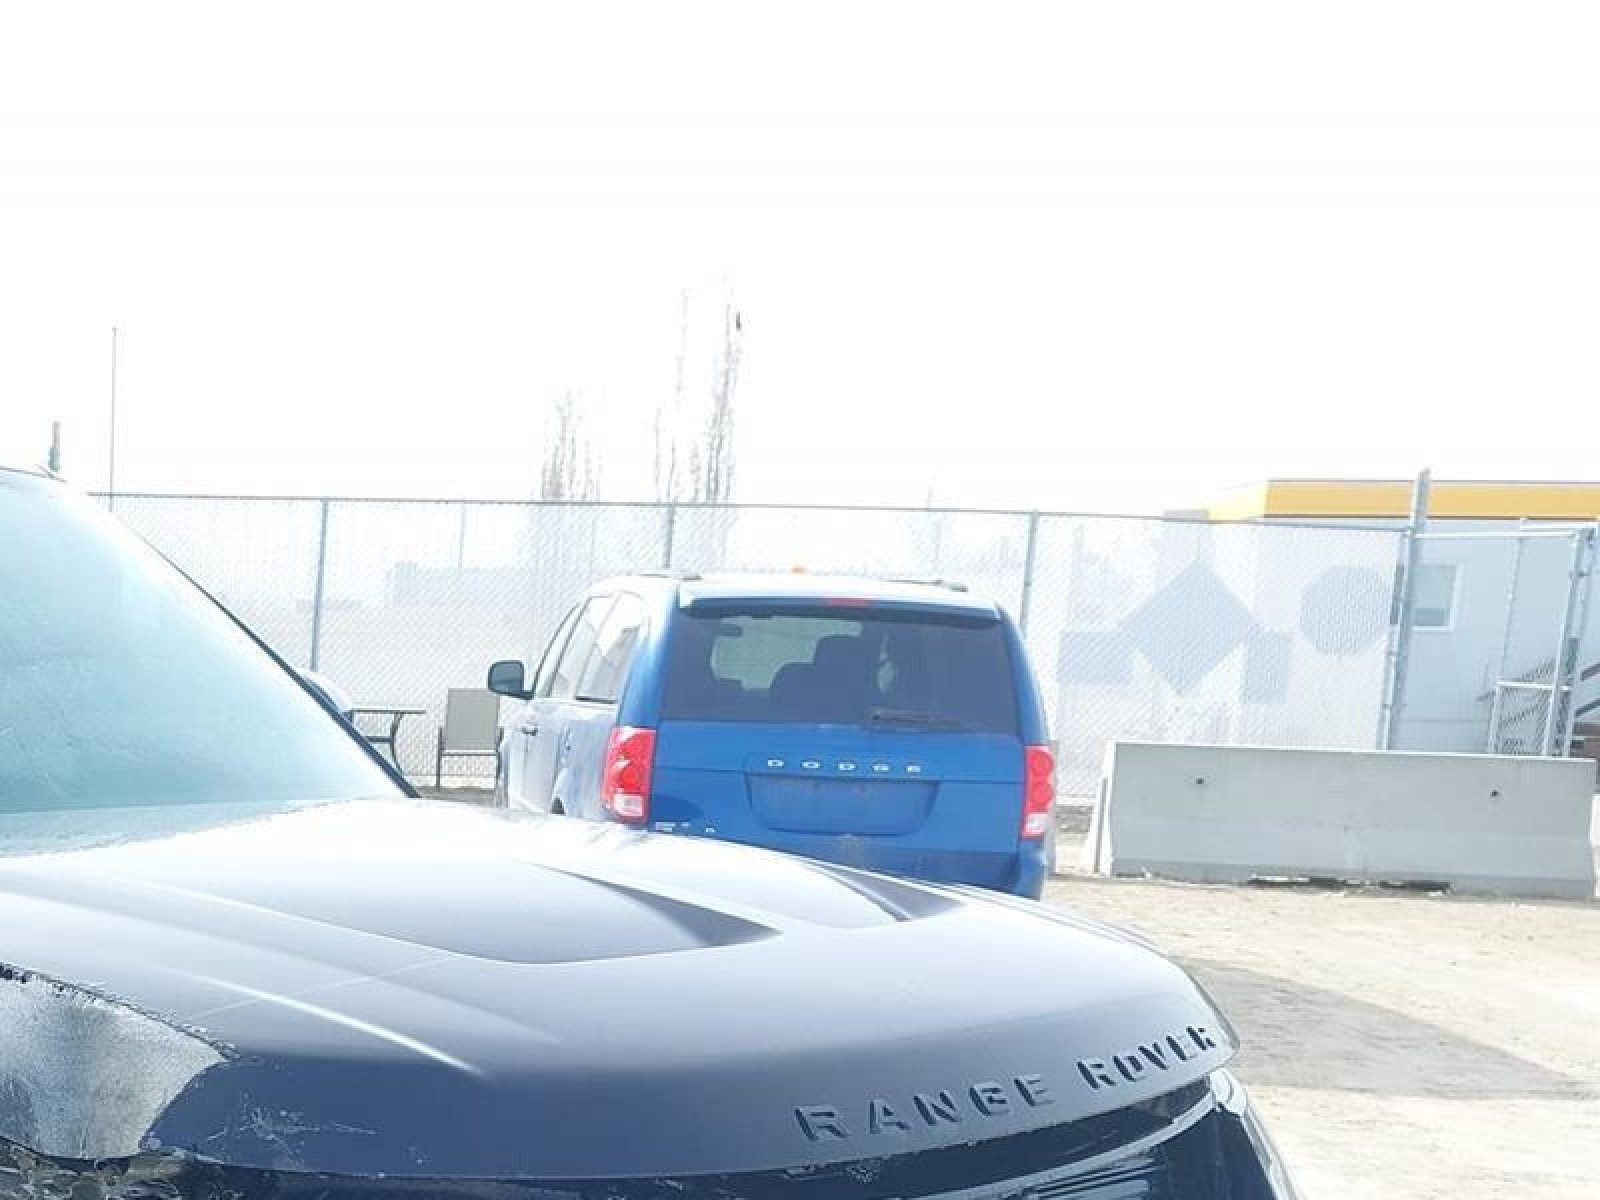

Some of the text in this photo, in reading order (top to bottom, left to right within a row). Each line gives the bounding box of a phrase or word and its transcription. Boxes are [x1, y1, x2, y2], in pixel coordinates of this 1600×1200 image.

[767, 758, 922, 773] DODGE
[794, 1025, 1217, 1140] RANGE ROVER
